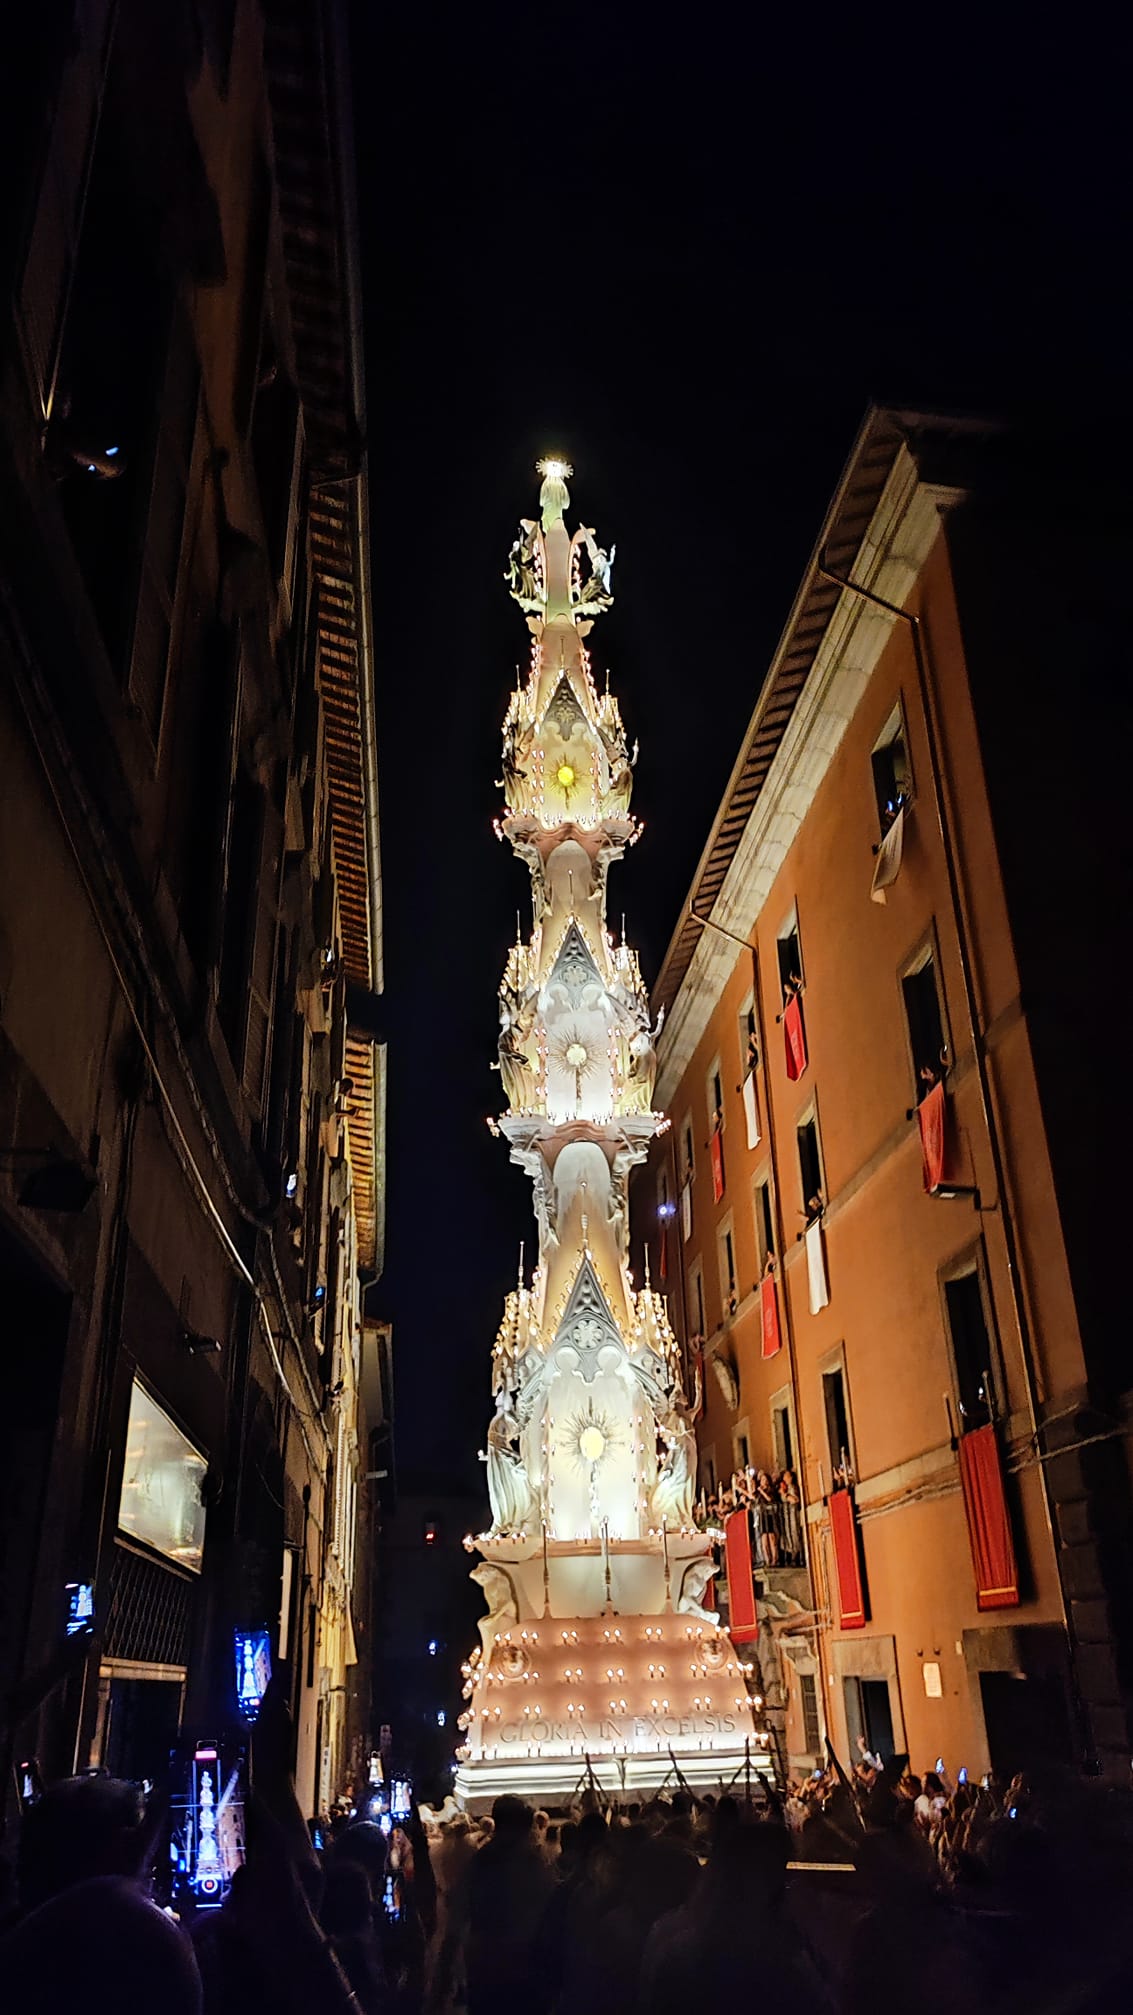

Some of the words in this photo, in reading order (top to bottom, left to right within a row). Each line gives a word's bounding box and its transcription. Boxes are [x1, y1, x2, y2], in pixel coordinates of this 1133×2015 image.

[500, 1720, 588, 1743] GLORIA
[599, 1718, 622, 1740] IN
[633, 1713, 736, 1737] EXCELSIS
